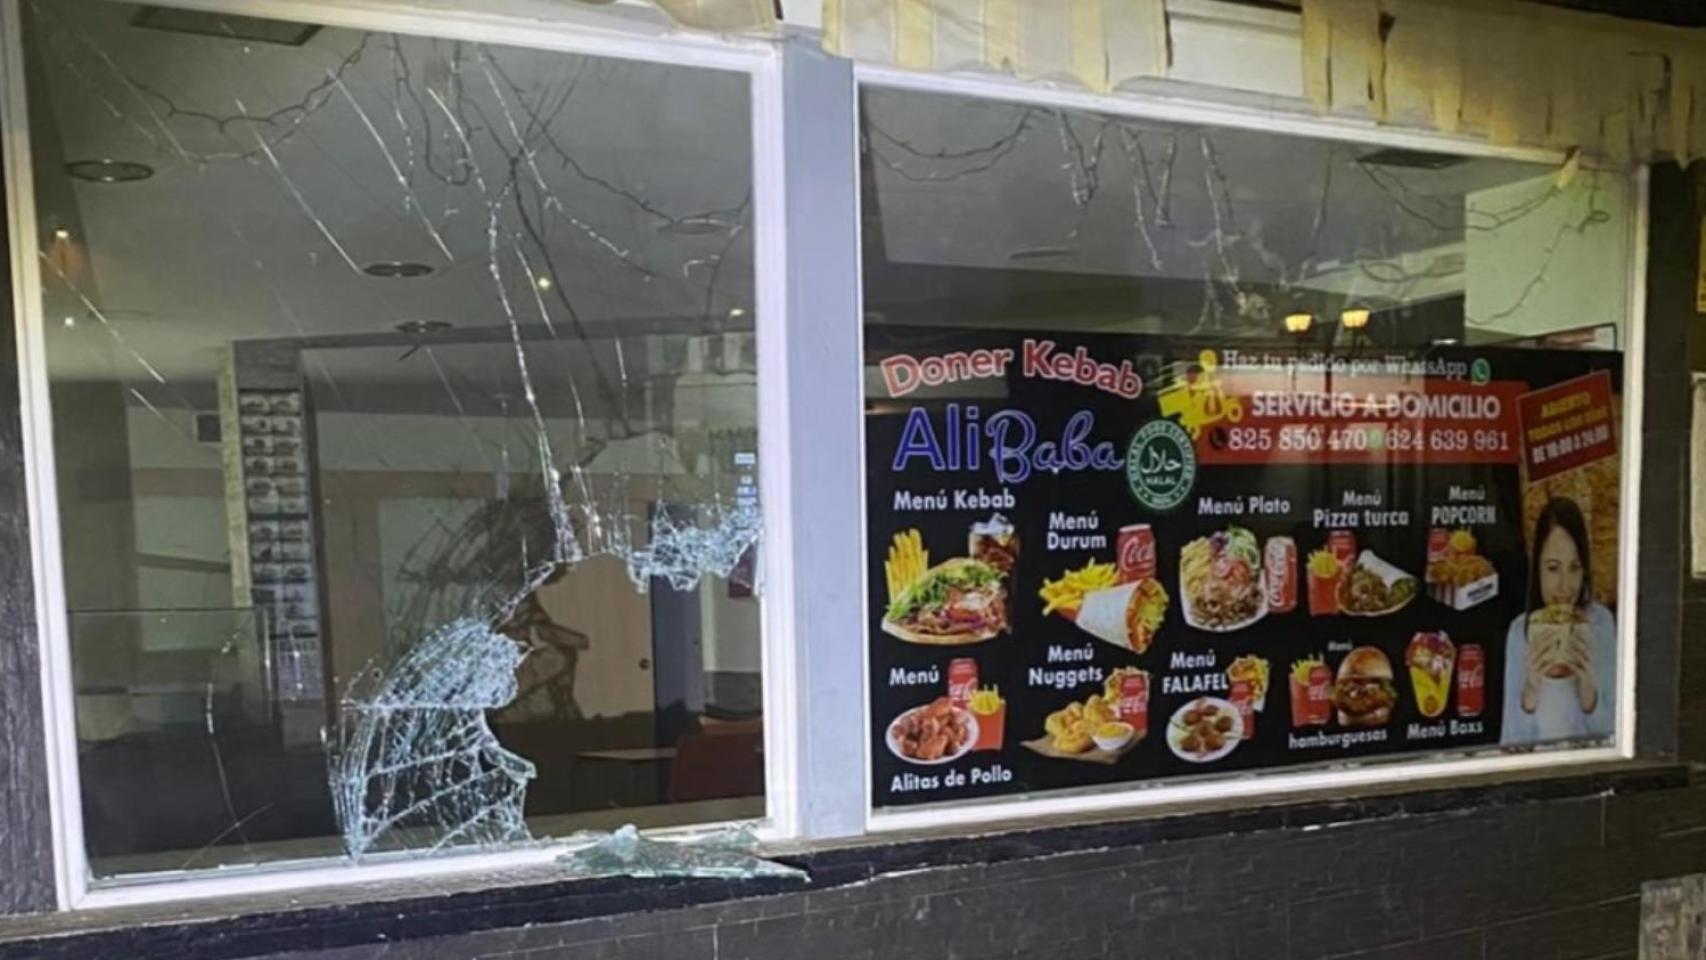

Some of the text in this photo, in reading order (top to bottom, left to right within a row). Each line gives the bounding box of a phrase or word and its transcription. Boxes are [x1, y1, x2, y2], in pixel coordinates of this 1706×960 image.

[880, 339, 1143, 399] Doner Kebab
[1223, 350, 1467, 381] Haz tu pedido por WhatsApp
[1252, 391, 1501, 419] SERVICIO A DOMICILIO
[892, 404, 1125, 483] Ali Baba
[1229, 427, 1509, 451] 825 850 470 624 639 961
[893, 488, 1015, 511] Menú Kebab
[1342, 489, 1382, 506] Menú
[1448, 484, 1485, 500] Menú
[1198, 496, 1291, 516] Menú Plato
[1431, 504, 1497, 525] POPCORN
[1049, 510, 1098, 531] Menú
[1313, 508, 1410, 528] Pizza turca
[1047, 532, 1106, 550] Durum
[1047, 643, 1094, 663] Menú
[1170, 649, 1216, 669] Menú
[889, 664, 939, 686] Menú
[1028, 666, 1103, 688] Nuggets
[1162, 673, 1229, 694] FALAFEL
[1288, 728, 1388, 750] hamburguesas
[1406, 719, 1484, 740] Menú Boxs
[890, 764, 1013, 793] Alitas de Pollo
